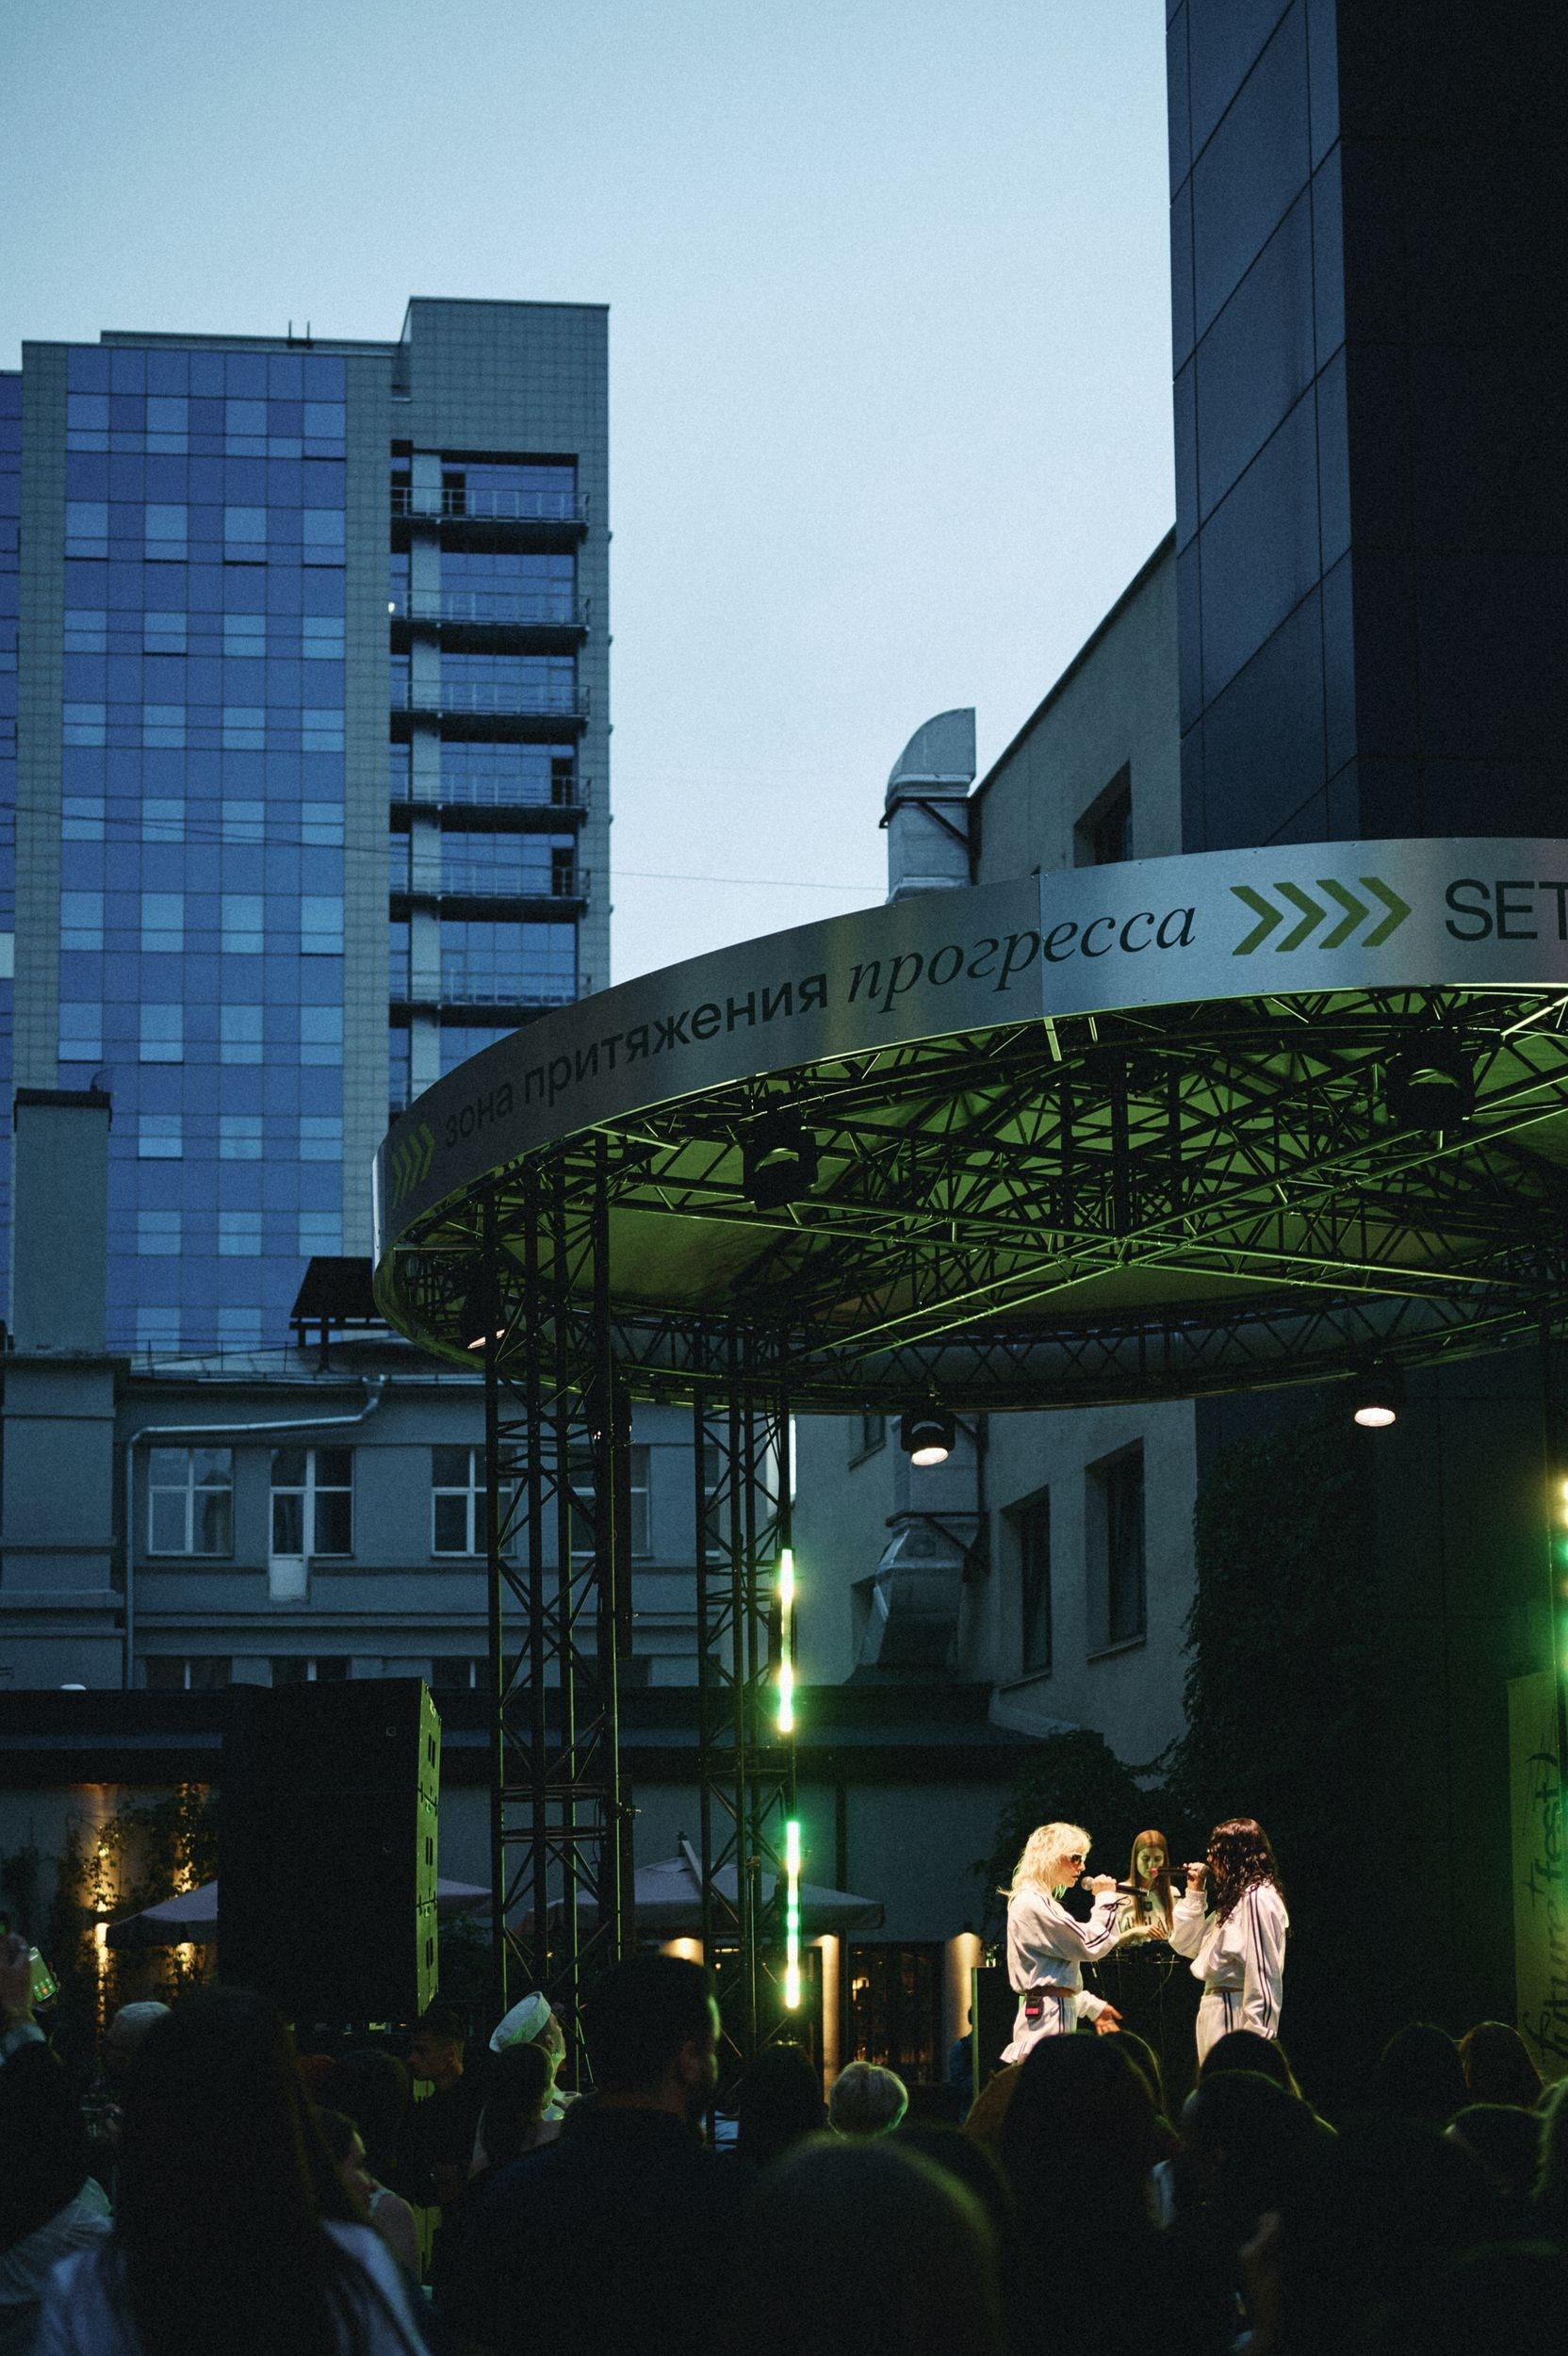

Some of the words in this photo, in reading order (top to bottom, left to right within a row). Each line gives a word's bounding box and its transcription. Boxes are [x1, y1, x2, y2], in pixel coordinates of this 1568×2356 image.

[1444, 877, 1568, 941] SET
[445, 1084, 514, 1148] зона
[525, 972, 828, 1108] притяжения
[847, 906, 1196, 1013] прогресса
